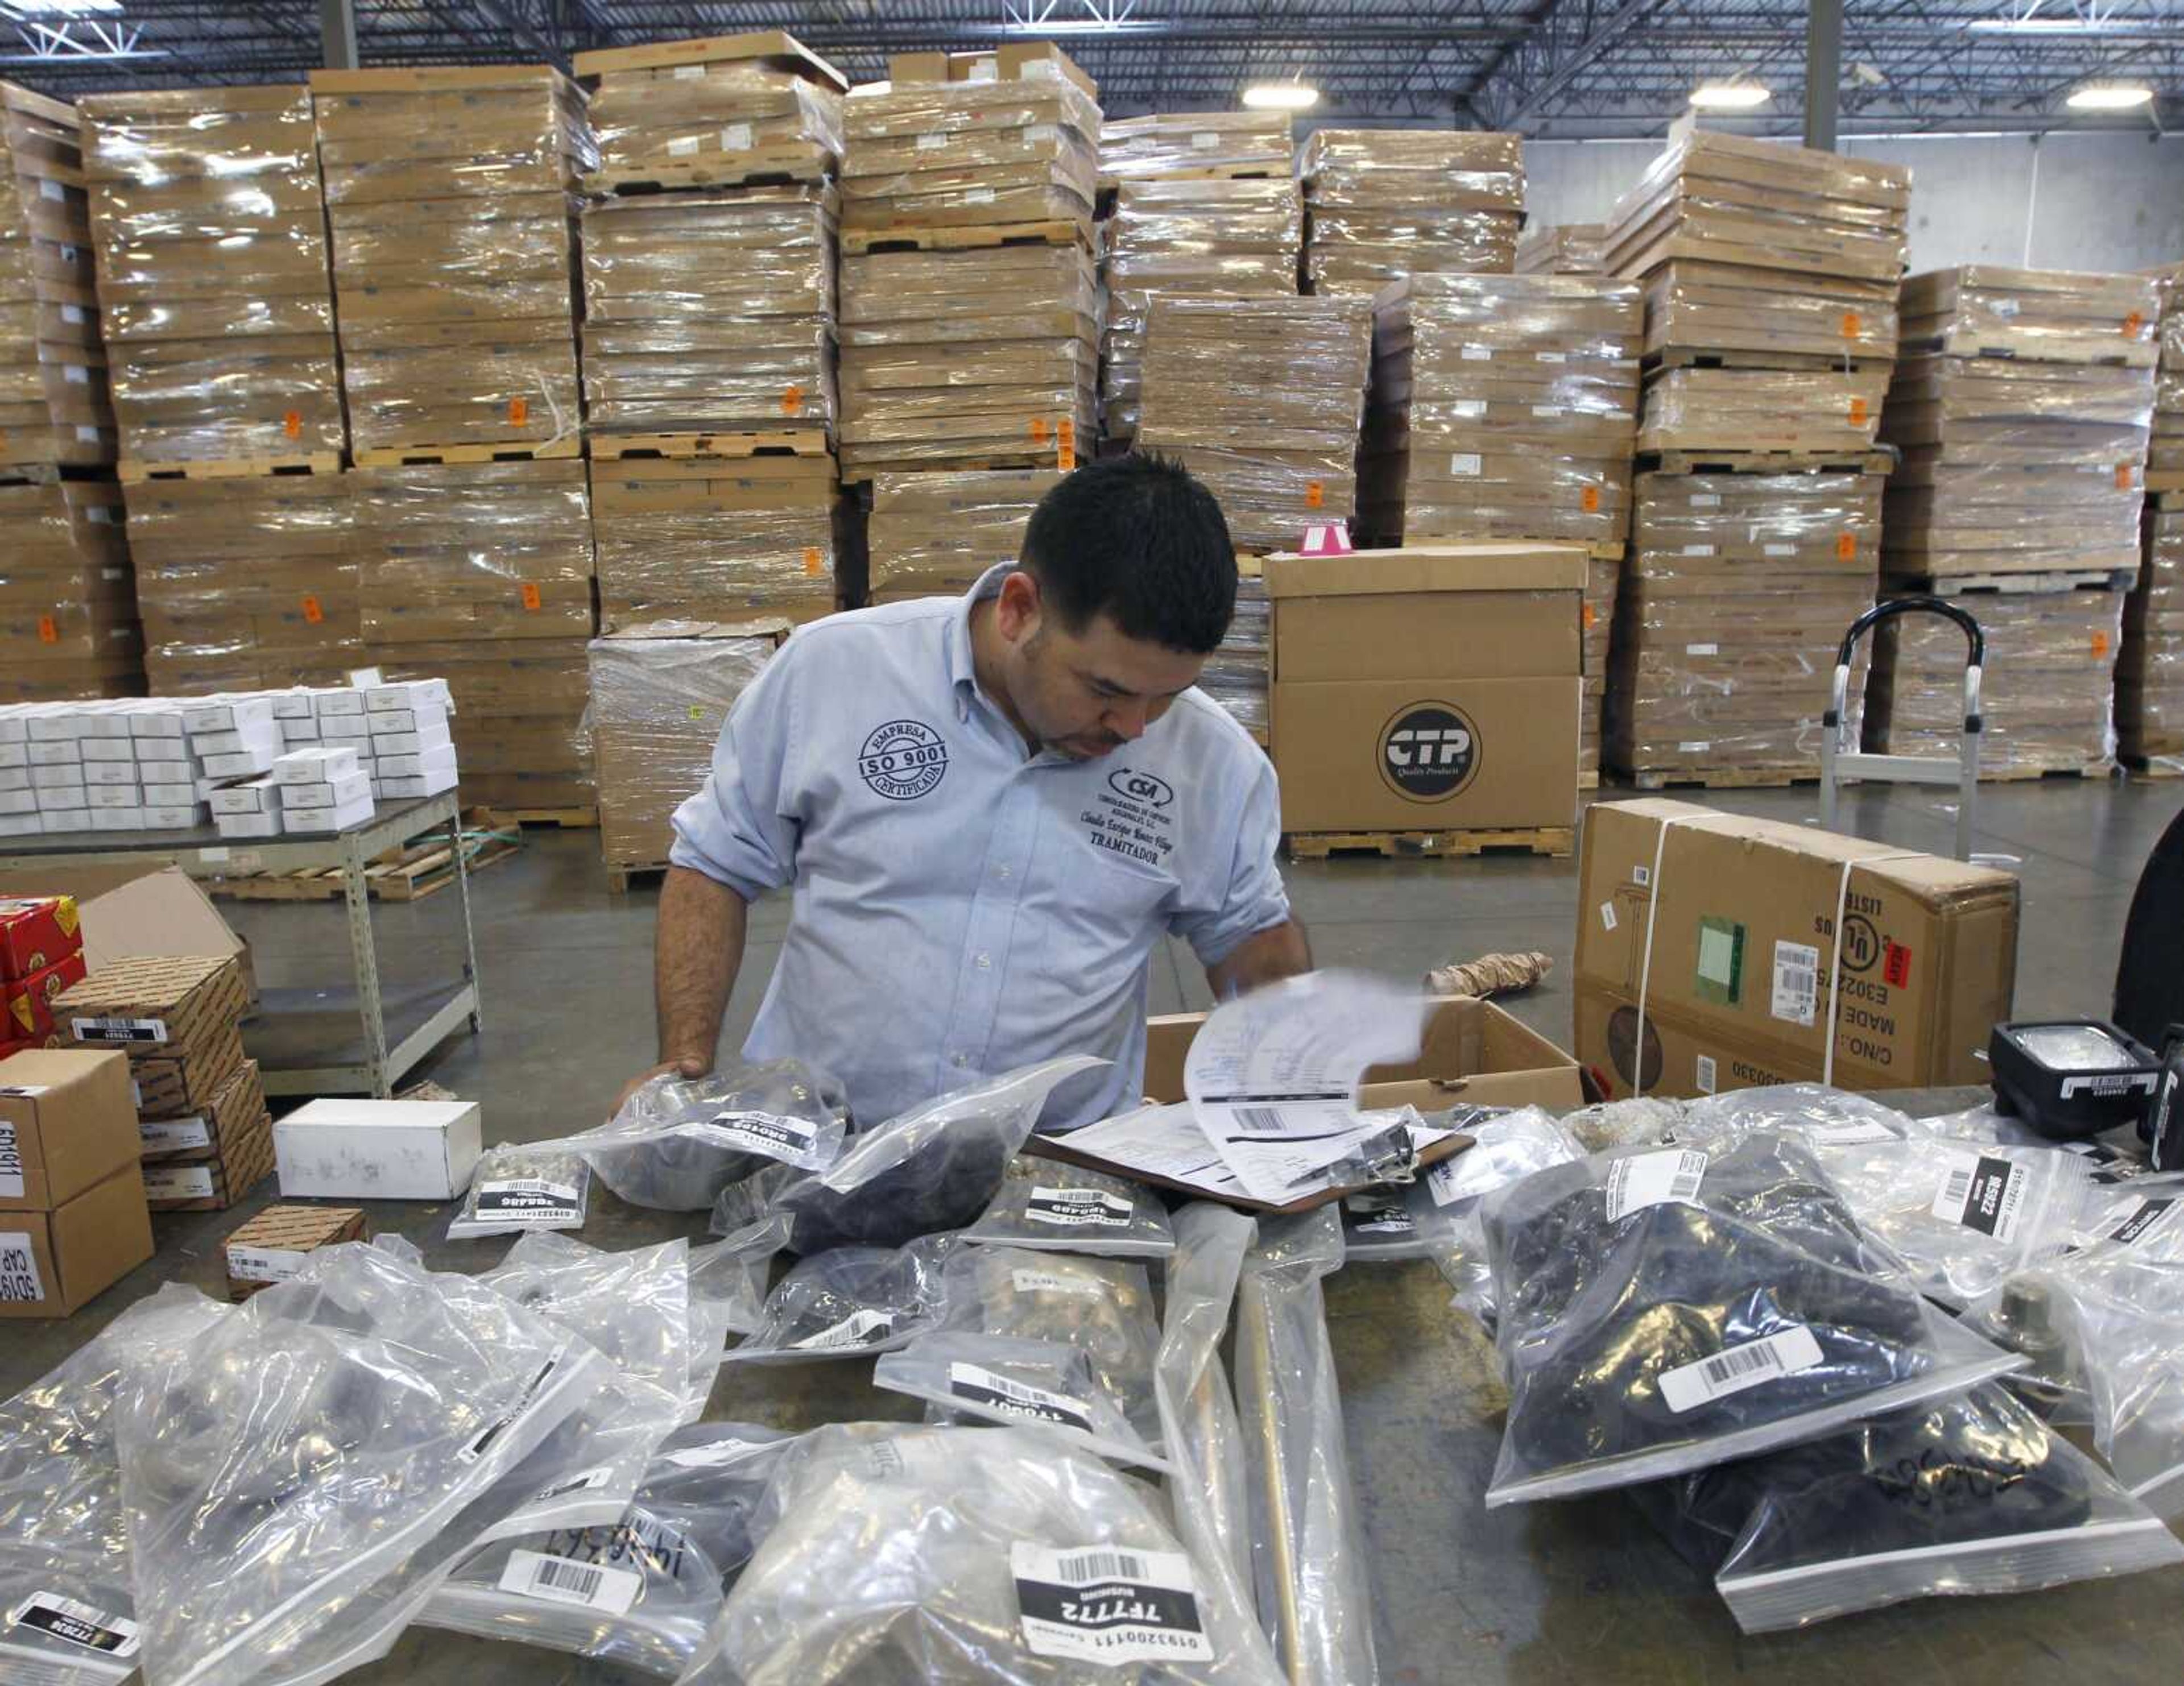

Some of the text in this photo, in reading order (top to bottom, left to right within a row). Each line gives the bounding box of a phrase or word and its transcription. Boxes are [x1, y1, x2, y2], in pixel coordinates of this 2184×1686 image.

[872, 725, 926, 750] EMPRESA
[1387, 730, 1470, 765] CTP
[859, 745, 947, 776] ISO 9001
[875, 767, 941, 795] CERTIFICADA
[1128, 778, 1159, 798] CSA
[1090, 831, 1158, 866] TRAMITADOR
[1848, 926, 1868, 960] UL
[1846, 1006, 1895, 1035] MADE
[1080, 1586, 1135, 1601] BUSHING
[1061, 1600, 1161, 1623] 7F7772
